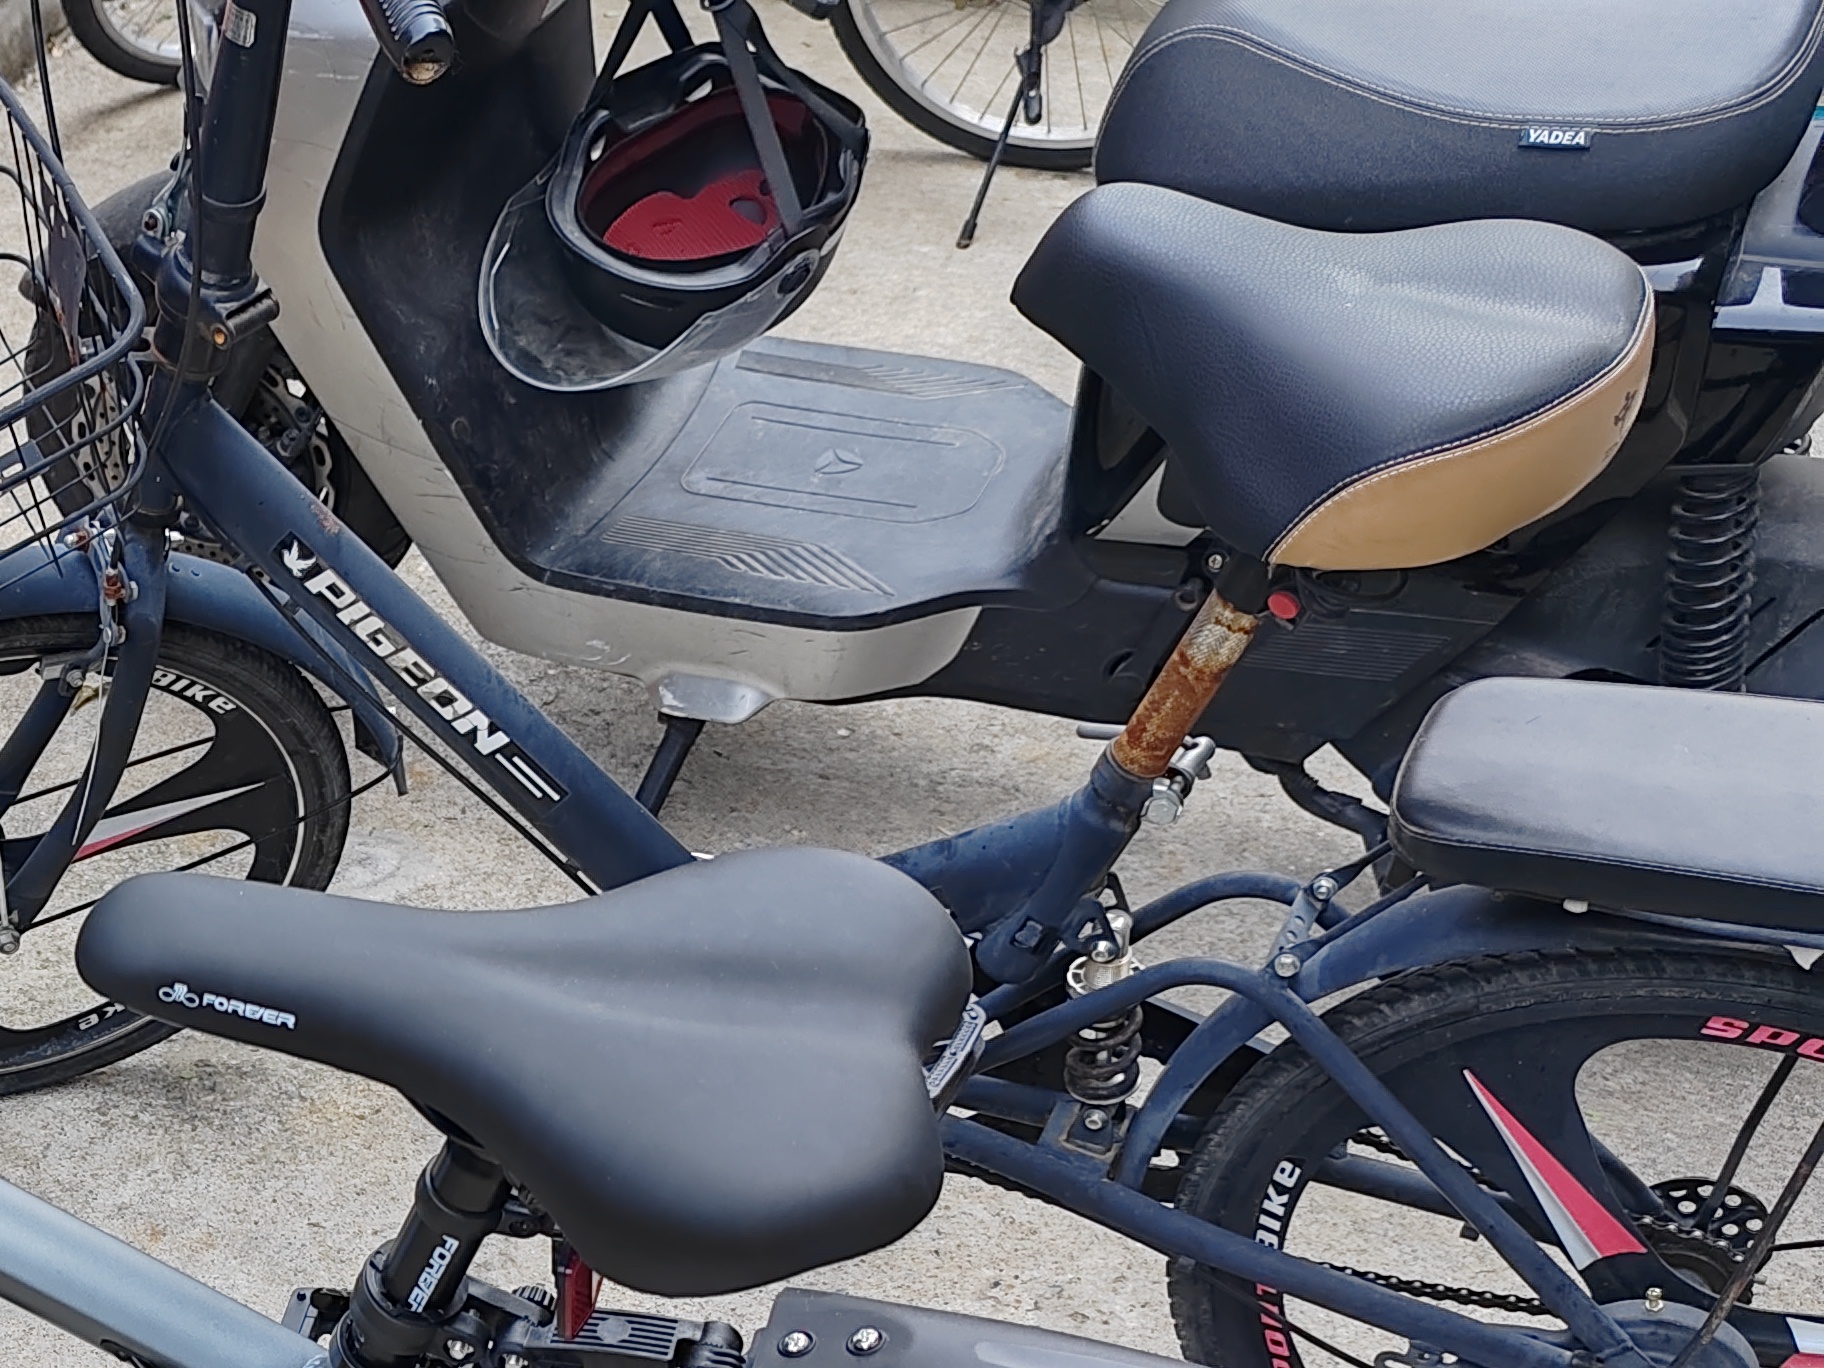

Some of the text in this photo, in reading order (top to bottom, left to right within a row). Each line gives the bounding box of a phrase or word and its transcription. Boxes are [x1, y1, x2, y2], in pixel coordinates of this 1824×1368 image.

[1528, 128, 1585, 145] YADEA
[303, 568, 511, 756] PIGEON
[201, 991, 298, 1031] FOREVER
